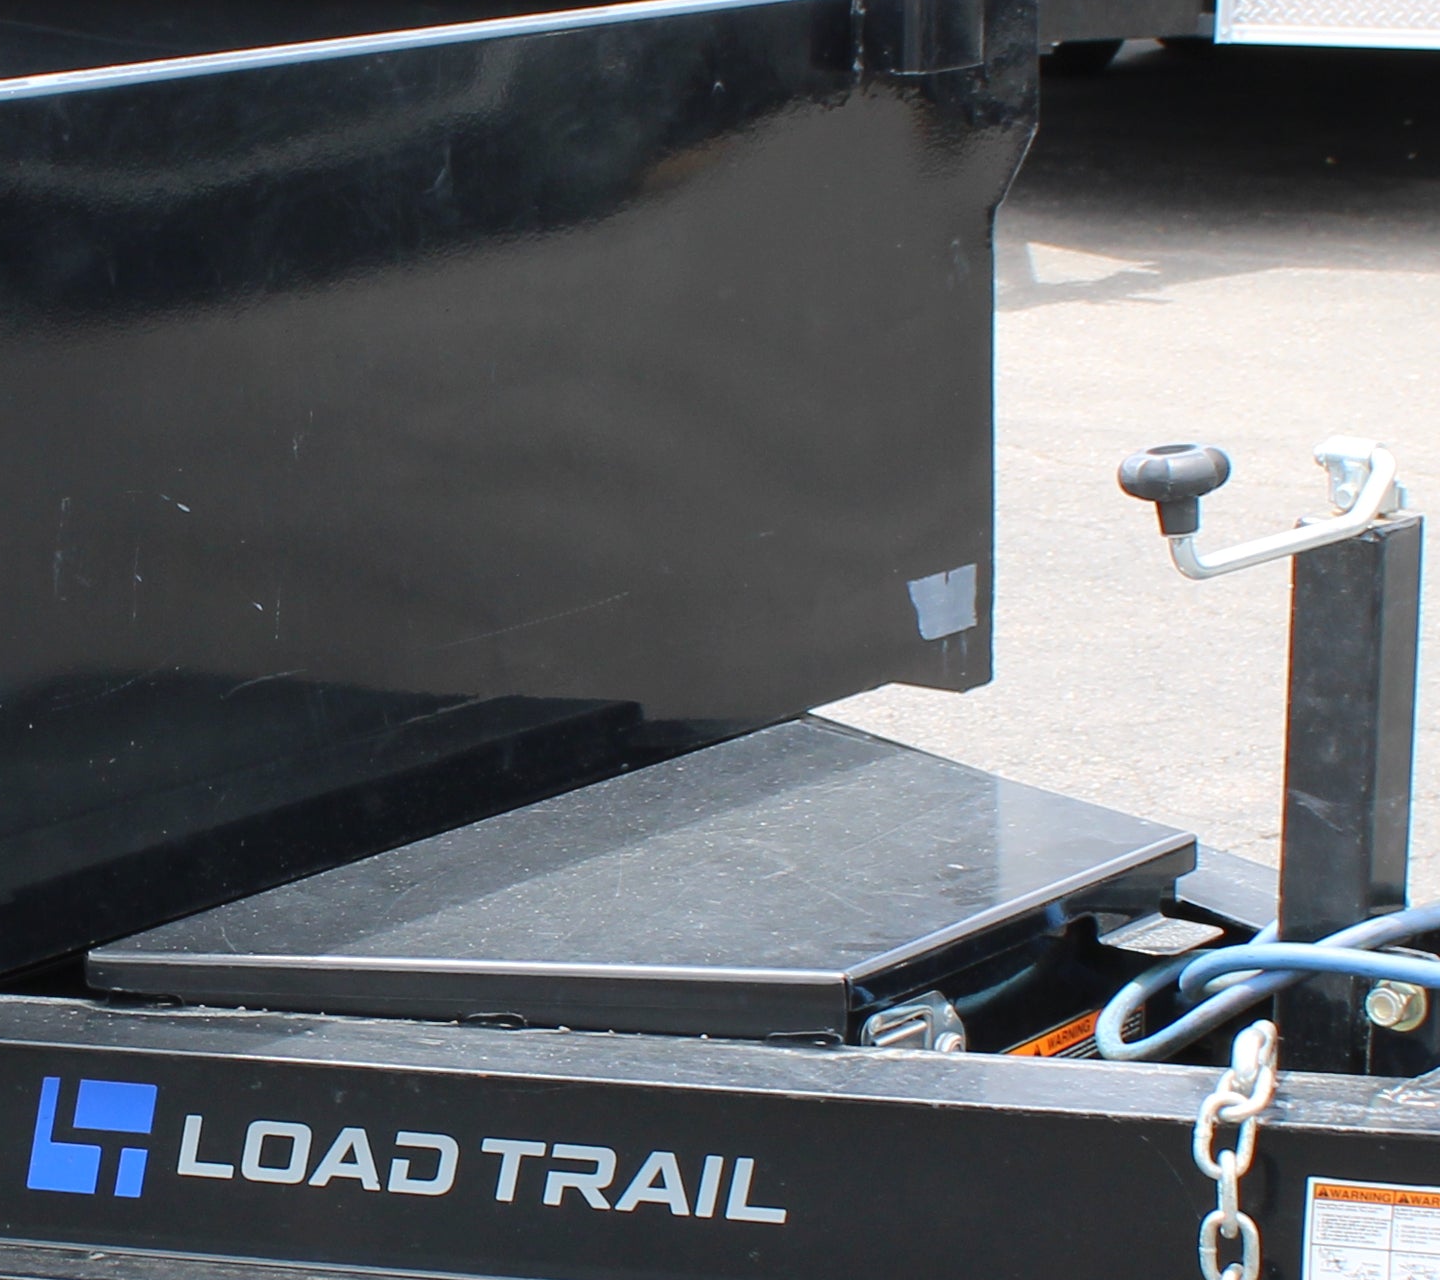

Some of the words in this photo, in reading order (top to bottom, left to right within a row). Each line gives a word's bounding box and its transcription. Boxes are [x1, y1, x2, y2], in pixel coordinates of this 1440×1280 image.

[1046, 1018, 1091, 1051] WARNING
[176, 1113, 460, 1197] LOAD
[480, 1136, 788, 1225] TRAIL
[1330, 1188, 1392, 1203] WARNING
